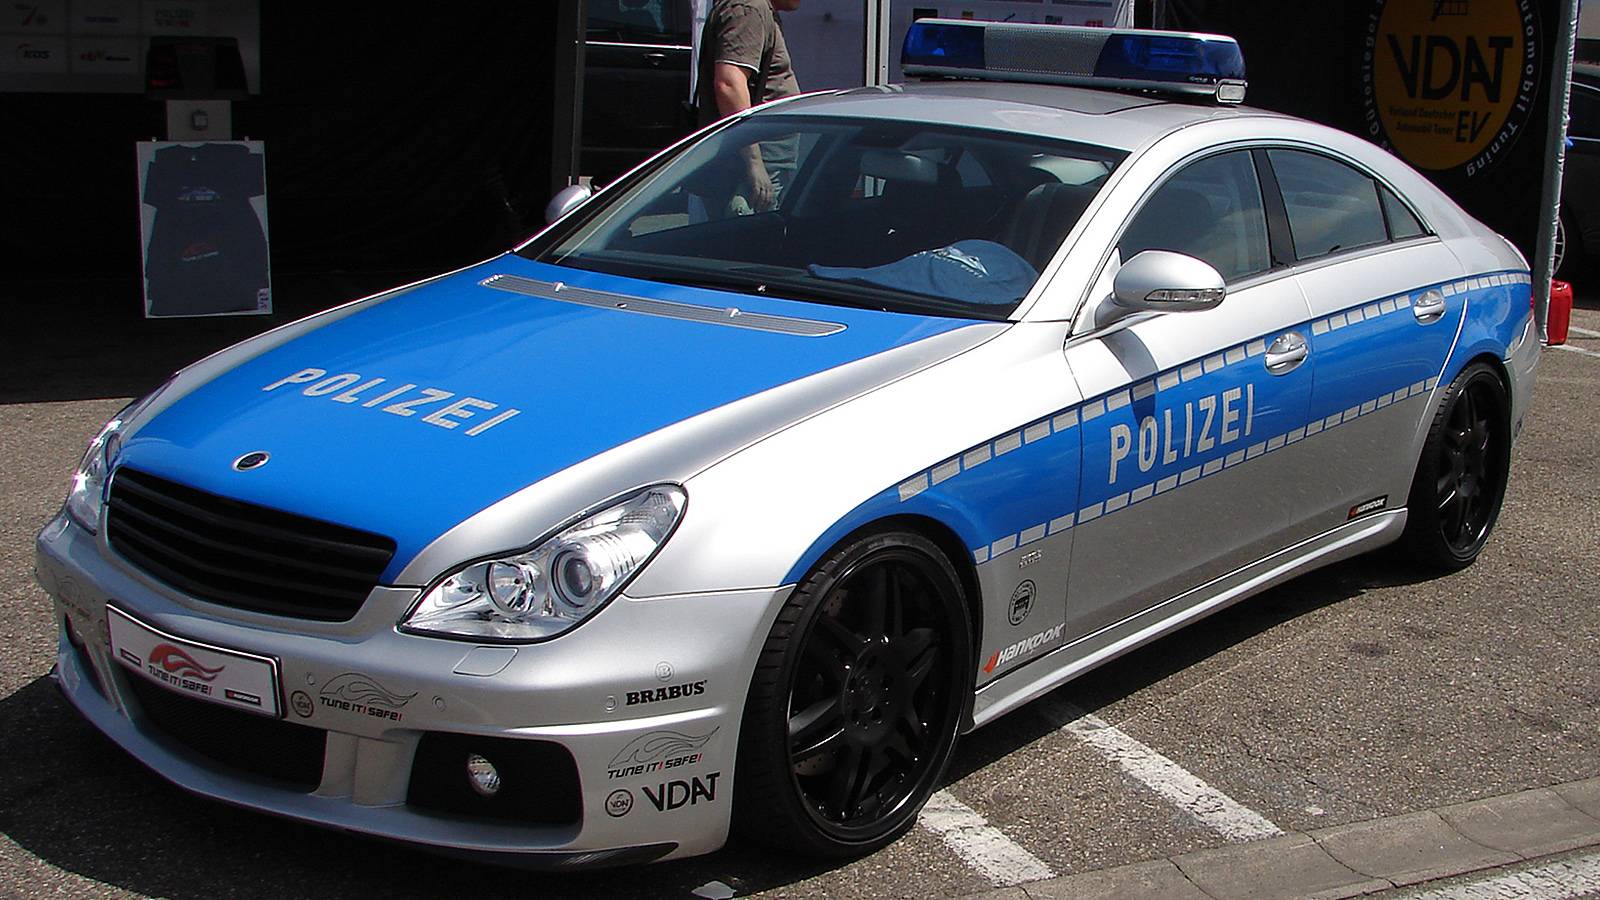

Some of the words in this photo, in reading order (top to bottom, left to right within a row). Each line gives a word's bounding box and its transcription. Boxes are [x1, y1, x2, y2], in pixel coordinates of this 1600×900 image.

[1387, 34, 1513, 103] VDAT
[1516, 0, 1536, 112] utomobil
[1456, 110, 1492, 143] EV
[1466, 122, 1518, 177] Tuning
[262, 368, 521, 437] POLIZEI
[1109, 383, 1254, 485] POLIZEI
[642, 772, 720, 812] VDAT
